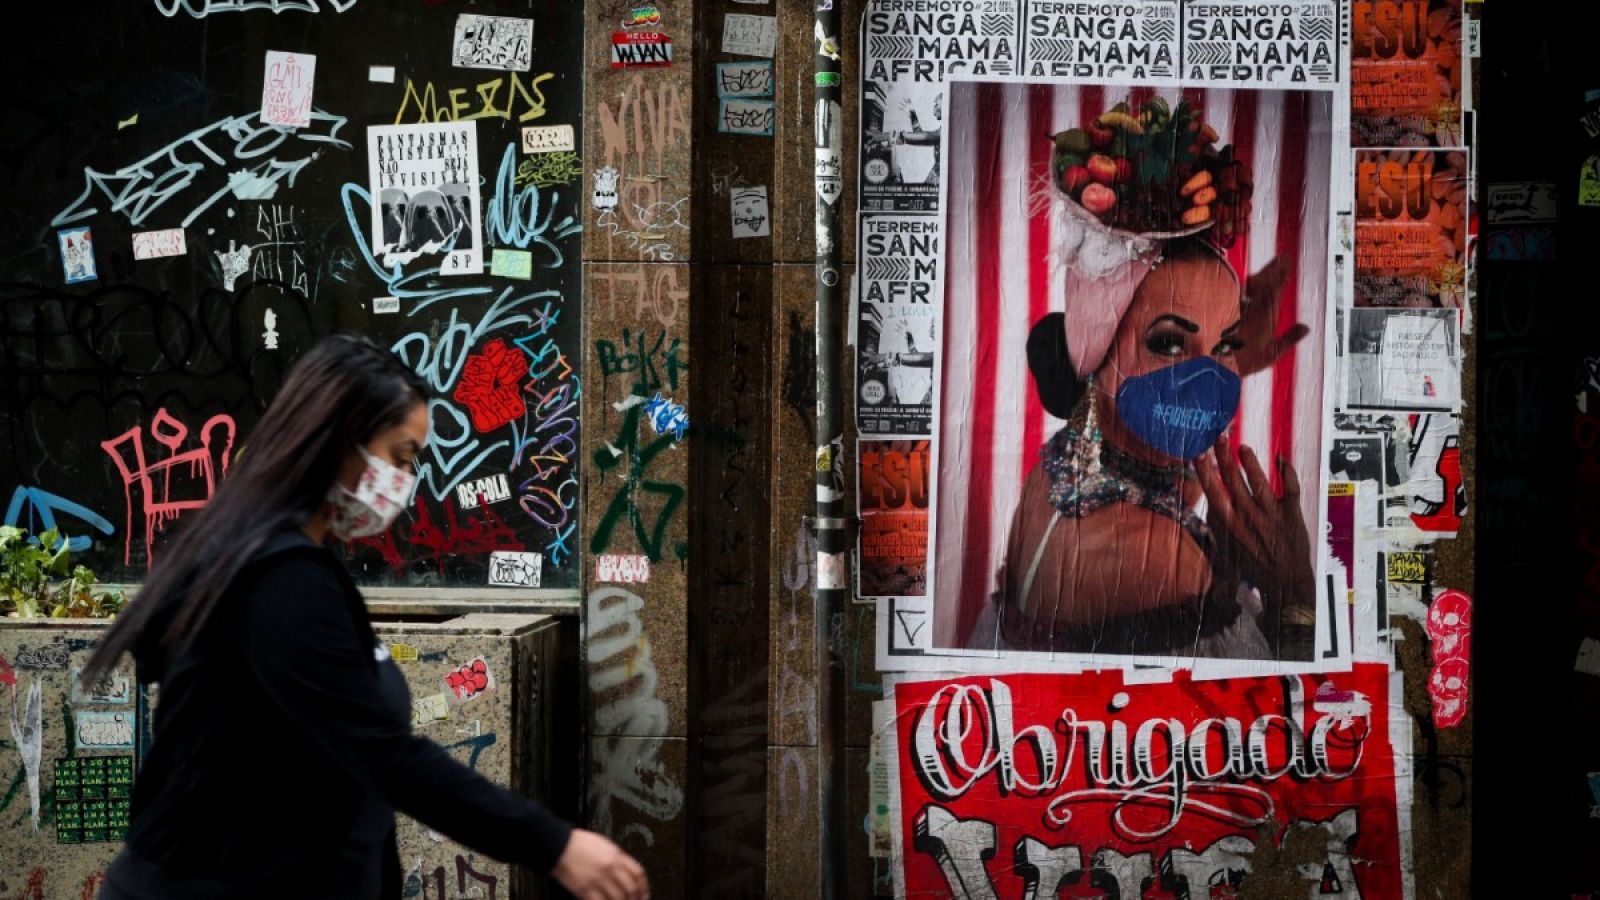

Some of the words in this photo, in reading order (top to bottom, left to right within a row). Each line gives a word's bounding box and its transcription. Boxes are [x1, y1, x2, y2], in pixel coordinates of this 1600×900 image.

[872, 0, 974, 12] TERREMOTO
[1032, 2, 1135, 17] TERREMOTO
[1188, 4, 1292, 17] TERREMOTO
[870, 13, 977, 36] SANGA
[1030, 15, 1138, 40] SANGA
[1187, 18, 1296, 40] SANGA
[918, 37, 1013, 60] MAMA
[1078, 40, 1172, 64] MAMA
[1236, 41, 1332, 64] MAMA
[377, 130, 468, 149] FANTASMAS
[445, 157, 469, 171] SEJA
